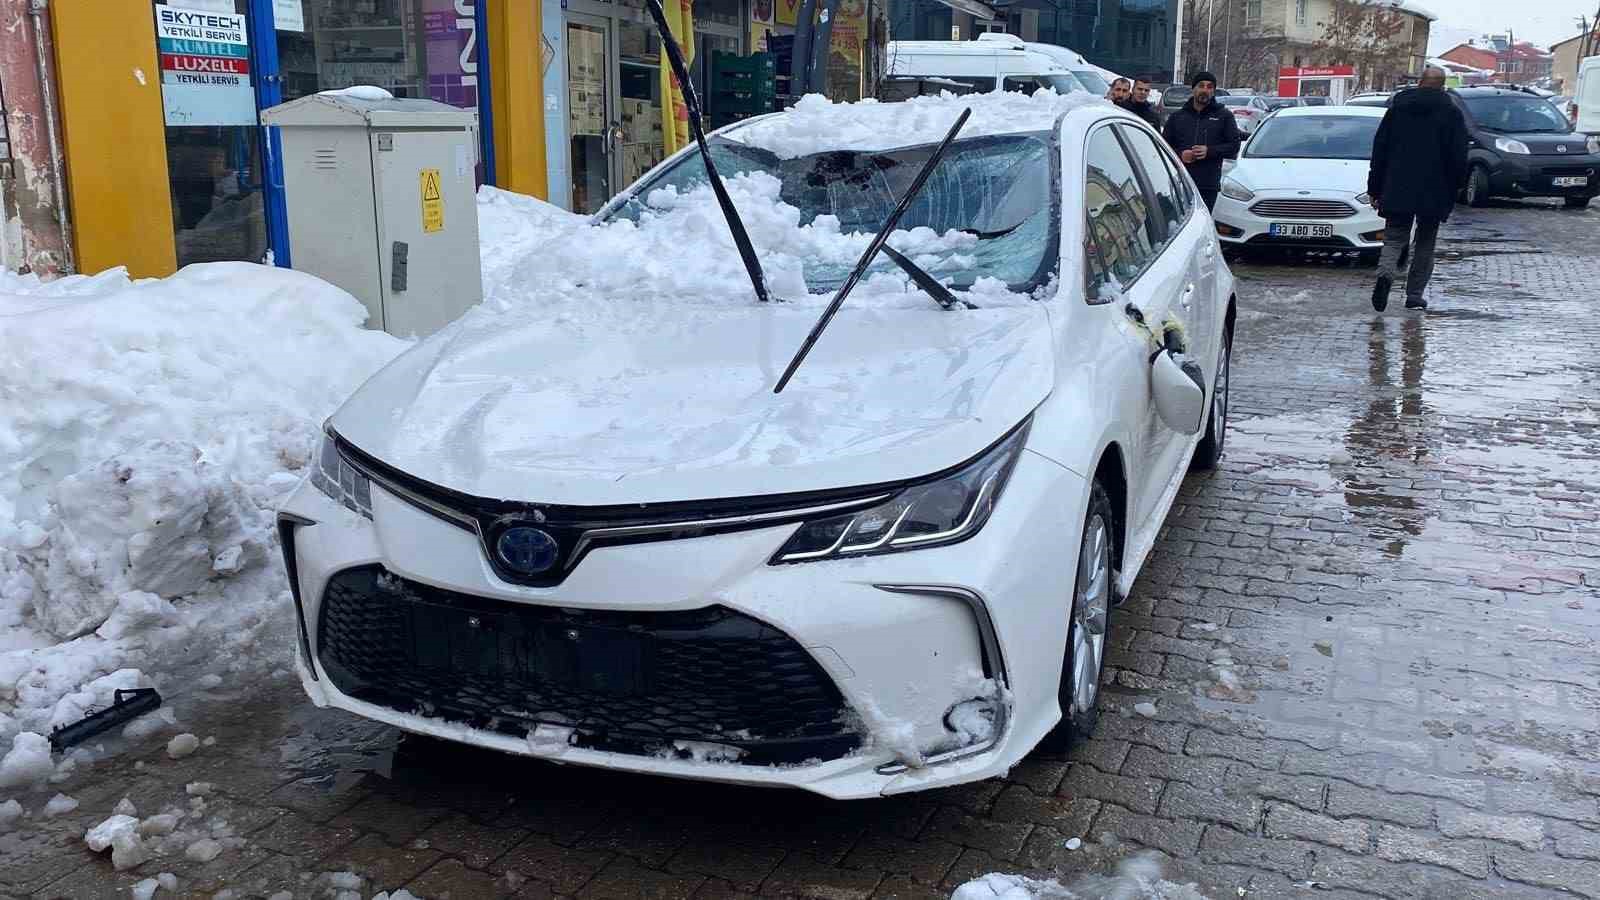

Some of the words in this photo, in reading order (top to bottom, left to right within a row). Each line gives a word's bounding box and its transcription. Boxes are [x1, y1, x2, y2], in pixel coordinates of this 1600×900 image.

[161, 10, 240, 29] SKYTECH
[163, 26, 202, 38] YETKİLİ
[206, 29, 241, 41] SERVİS
[174, 57, 238, 72] LUXELL
[176, 74, 209, 84] YETKİLİ
[211, 75, 239, 85] SERVİS
[1276, 224, 1288, 235] 33
[1312, 226, 1330, 236] 596
